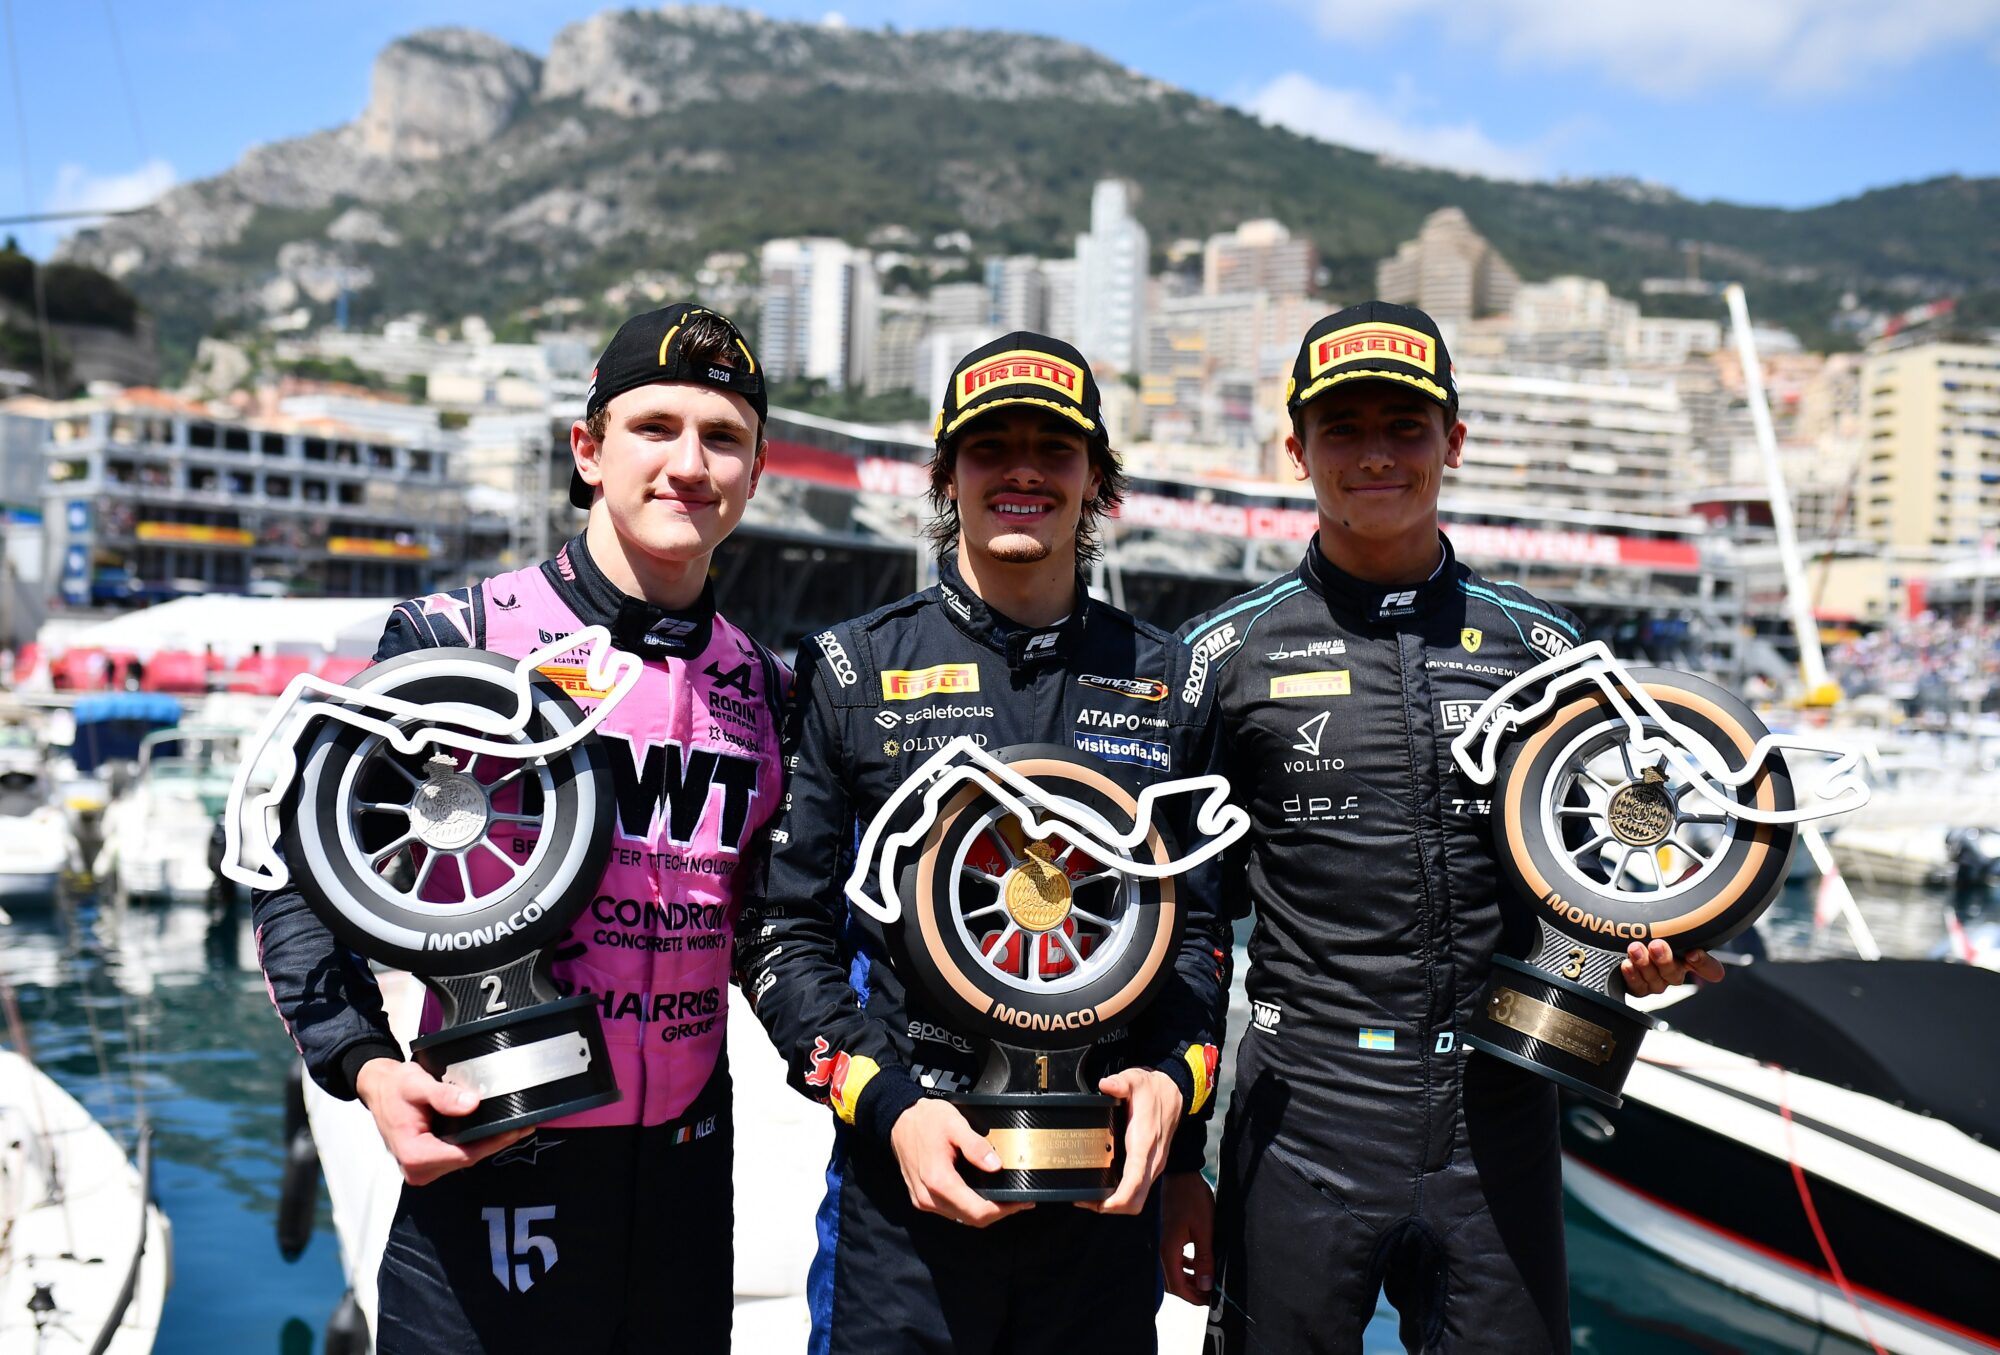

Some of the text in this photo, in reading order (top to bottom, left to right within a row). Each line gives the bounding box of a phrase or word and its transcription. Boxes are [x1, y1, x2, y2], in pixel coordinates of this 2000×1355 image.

[1319, 330, 1427, 365] PIRELLI
[965, 356, 1075, 395] PIRELLI
[1381, 590, 1417, 608] F2
[649, 617, 698, 637] F2
[1025, 632, 1060, 652] F2
[817, 631, 858, 686] sparco
[1466, 664, 1520, 677] ACADEMY
[890, 669, 969, 694] PIRELLI
[709, 691, 757, 725] RODIN
[905, 704, 994, 724] scalefocus
[1076, 738, 1168, 766] visitsofia.bg
[1283, 758, 1345, 774] VOLITO
[1282, 794, 1358, 815] dps
[427, 902, 543, 950] MONACO
[591, 895, 727, 930] CONDRON
[1546, 893, 1647, 939] MONACO
[1562, 948, 1586, 978] 3
[480, 975, 507, 1014] 2
[598, 987, 720, 1022] HARRIS
[661, 1017, 716, 1042] GROUP
[992, 1003, 1095, 1031] MONACO
[1035, 1055, 1048, 1089] 1
[695, 1117, 717, 1140] ALEX
[481, 1205, 559, 1293] 15
